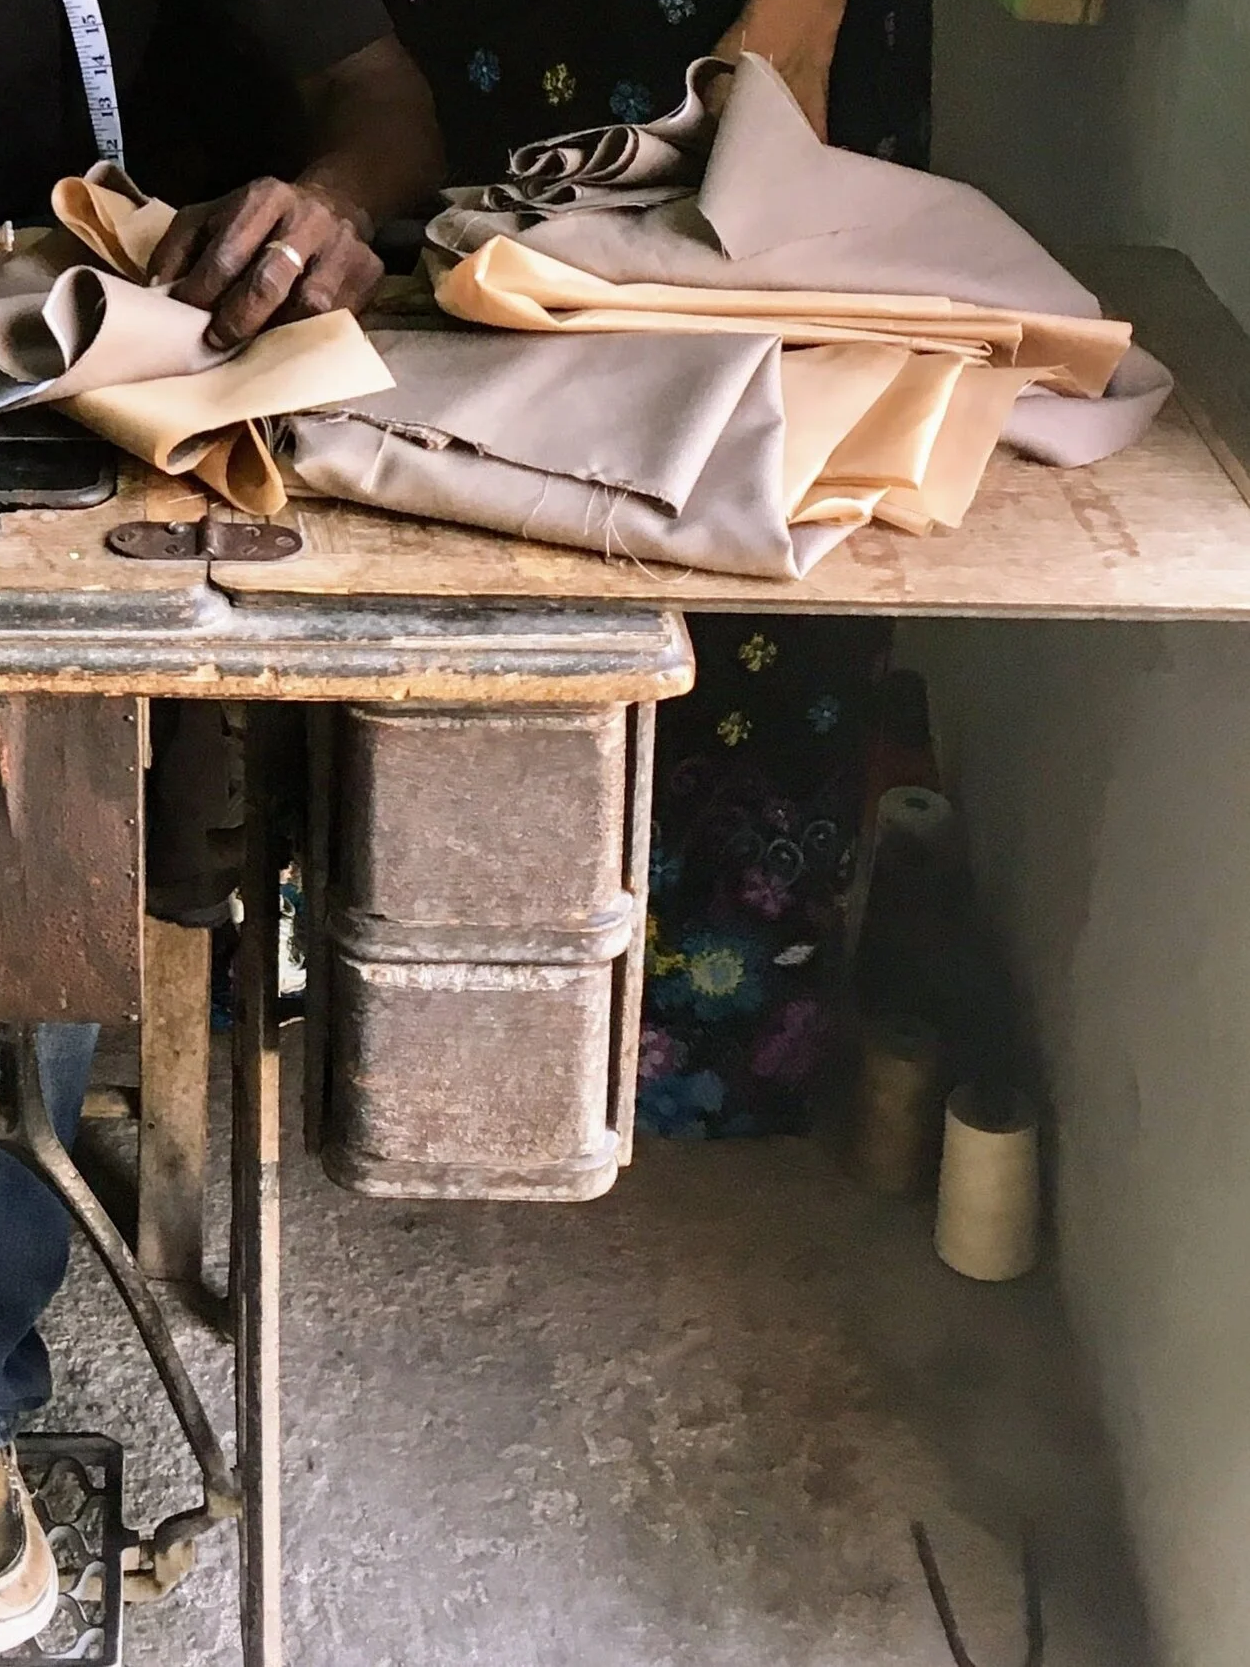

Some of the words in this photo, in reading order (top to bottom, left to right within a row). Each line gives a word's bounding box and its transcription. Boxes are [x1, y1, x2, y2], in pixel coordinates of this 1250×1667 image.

[82, 14, 99, 34] 15
[92, 54, 107, 75] 14
[99, 96, 113, 118] 13
